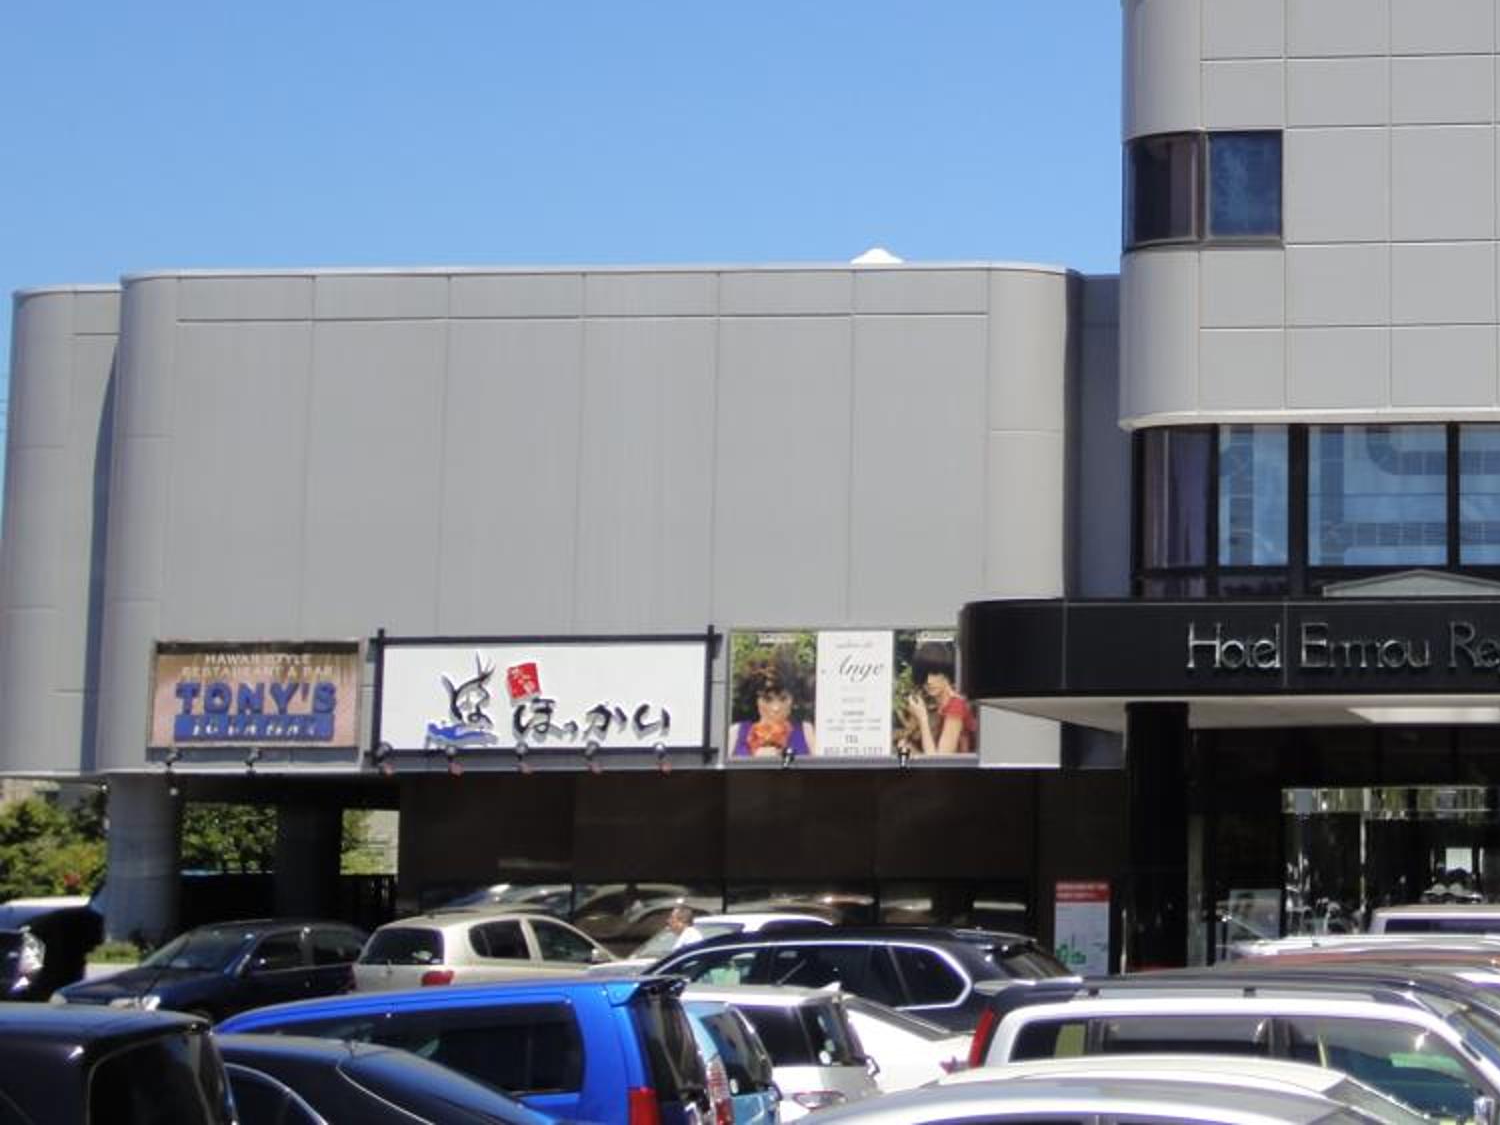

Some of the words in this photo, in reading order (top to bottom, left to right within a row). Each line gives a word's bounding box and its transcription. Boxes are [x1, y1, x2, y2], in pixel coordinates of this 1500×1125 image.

[1186, 622, 1282, 669] Hotel
[1299, 622, 1431, 669] Ermou
[175, 682, 337, 715] TONY'S
